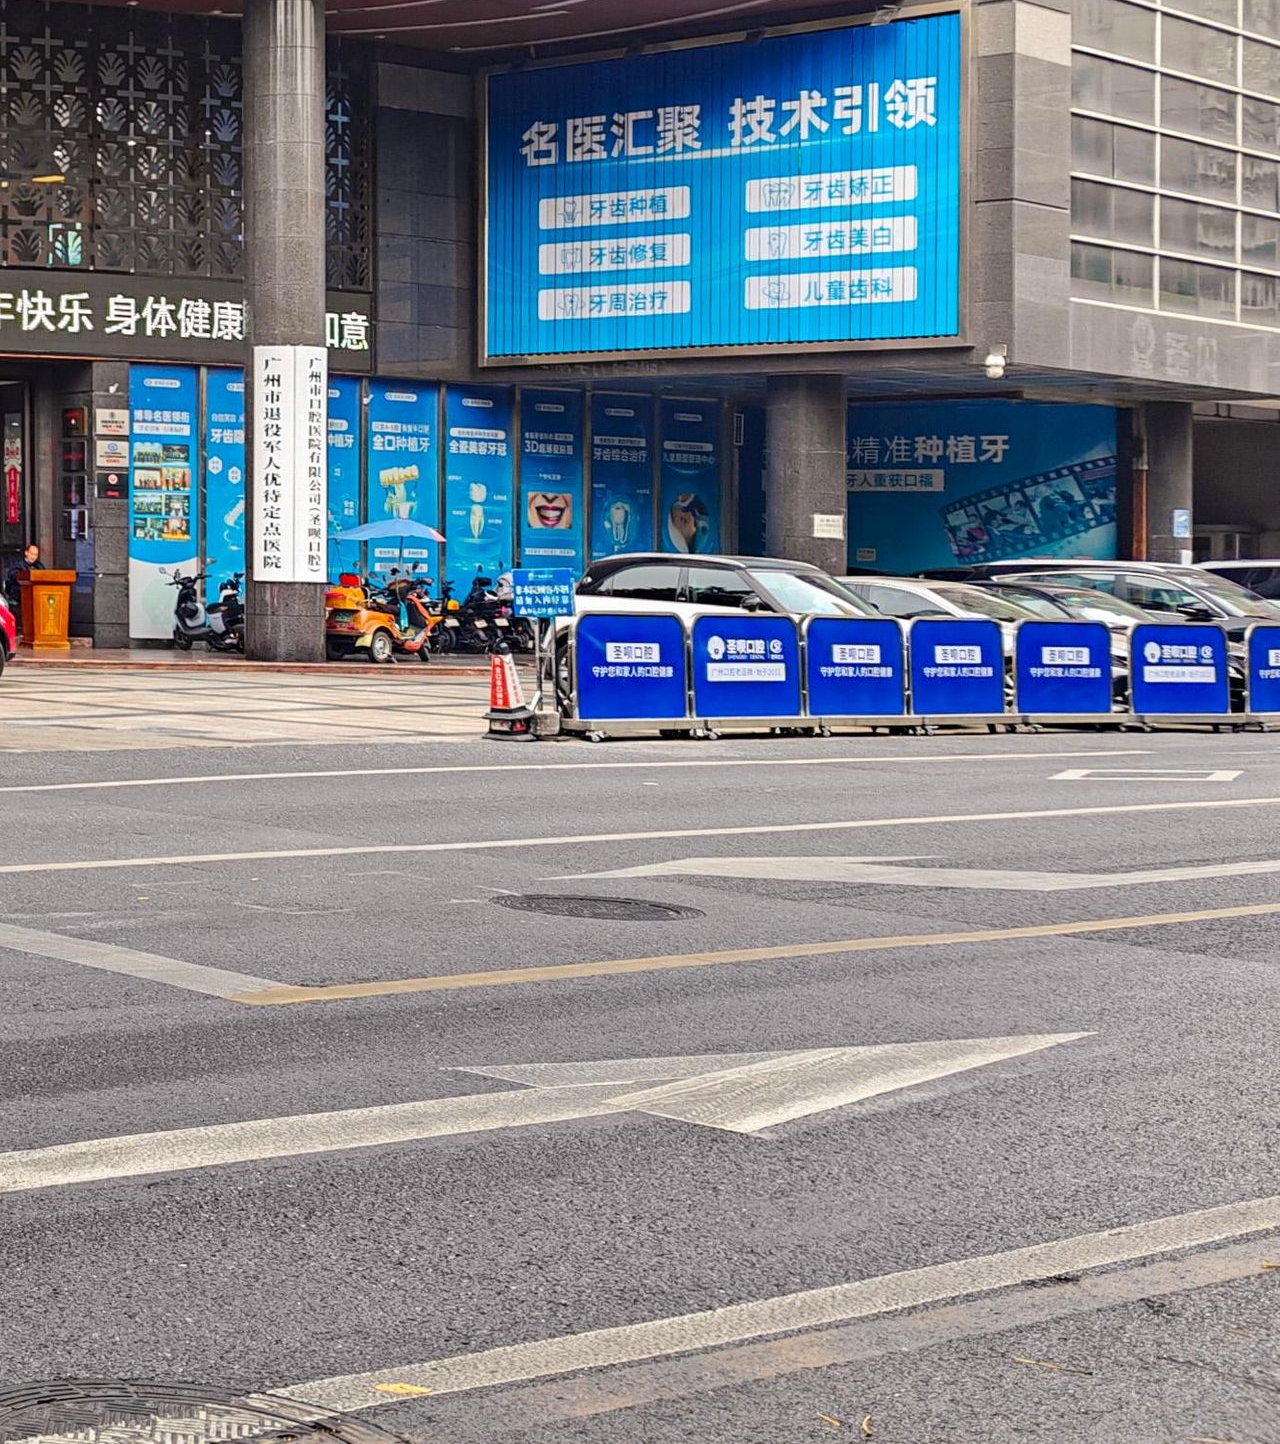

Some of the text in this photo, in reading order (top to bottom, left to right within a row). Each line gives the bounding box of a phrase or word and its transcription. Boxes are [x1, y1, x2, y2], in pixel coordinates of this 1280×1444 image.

[519, 76, 938, 167] 名医汇聚 技术引领
[803, 175, 893, 202] 牙齿矫正
[588, 194, 668, 219] 牙齿种植
[803, 224, 893, 253] 牙齿美白
[588, 243, 669, 267] 牙齿修复
[803, 275, 894, 303] 儿童齿科
[588, 291, 669, 314] 牙周治疗
[105, 294, 244, 341] 身体健康
[372, 434, 431, 453] 全口种植牙
[847, 434, 1010, 465] 精准种植牙
[263, 357, 282, 569] 广州市退役军人优待定点医院
[613, 645, 654, 660] 圣呗口腔
[726, 639, 766, 654] 圣呗口腔
[839, 647, 876, 662] 圣呗口腔
[941, 648, 976, 661] 圣呗口腔
[1048, 649, 1084, 662] 圣呗口腔
